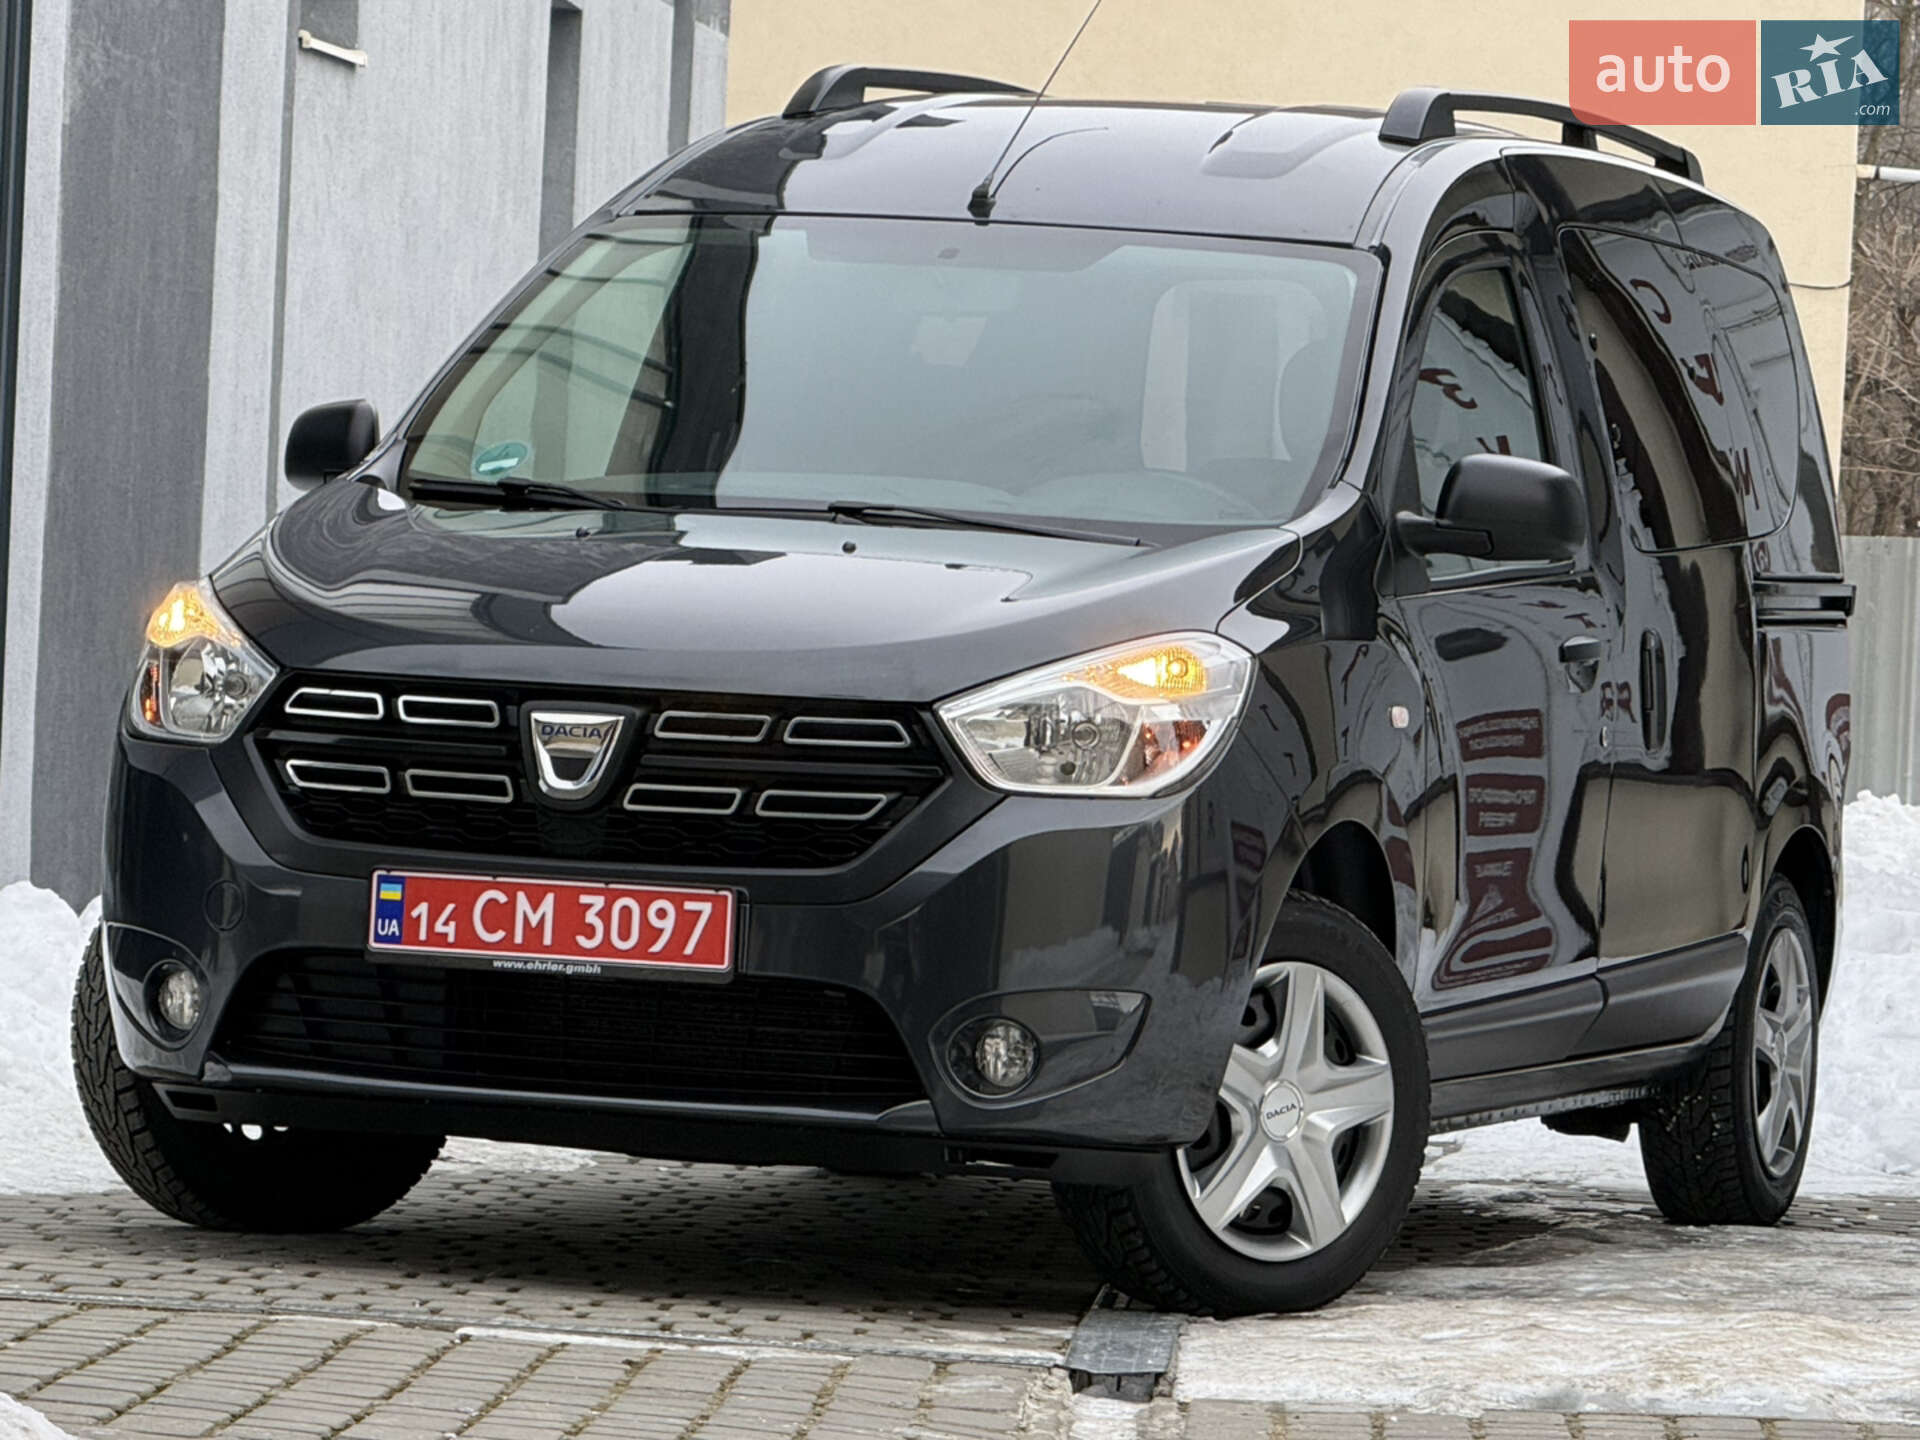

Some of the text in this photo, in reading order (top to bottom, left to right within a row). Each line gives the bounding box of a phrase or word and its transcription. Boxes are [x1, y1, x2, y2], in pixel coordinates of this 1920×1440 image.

[541, 723, 603, 739] DACIA
[377, 918, 400, 937] UA
[410, 889, 713, 956] 14 CM 3097
[1265, 1102, 1297, 1120] DACIA
